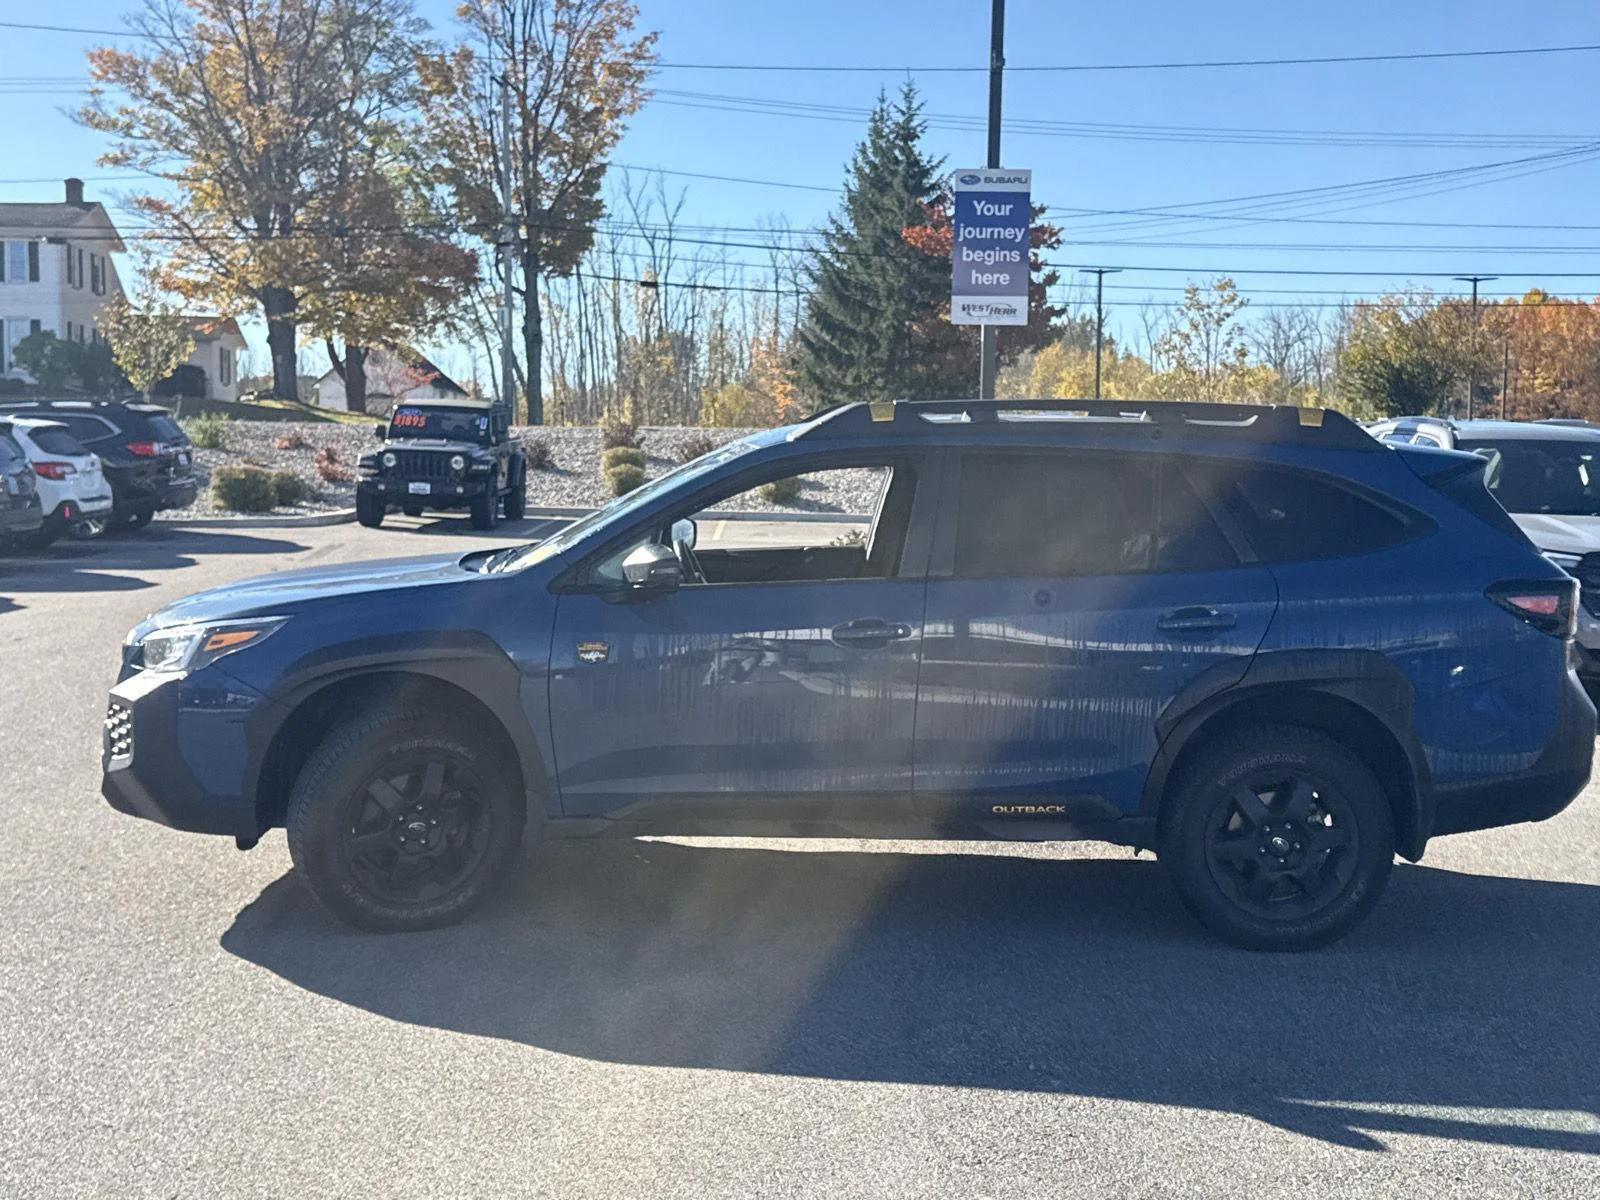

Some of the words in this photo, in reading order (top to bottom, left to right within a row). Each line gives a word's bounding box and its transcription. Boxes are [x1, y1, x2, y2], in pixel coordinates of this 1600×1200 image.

[973, 200, 1013, 216] Your
[958, 224, 1025, 242] journey
[962, 247, 1020, 265] begins
[971, 270, 1010, 285] here
[992, 805, 1066, 813] OUTBACK
